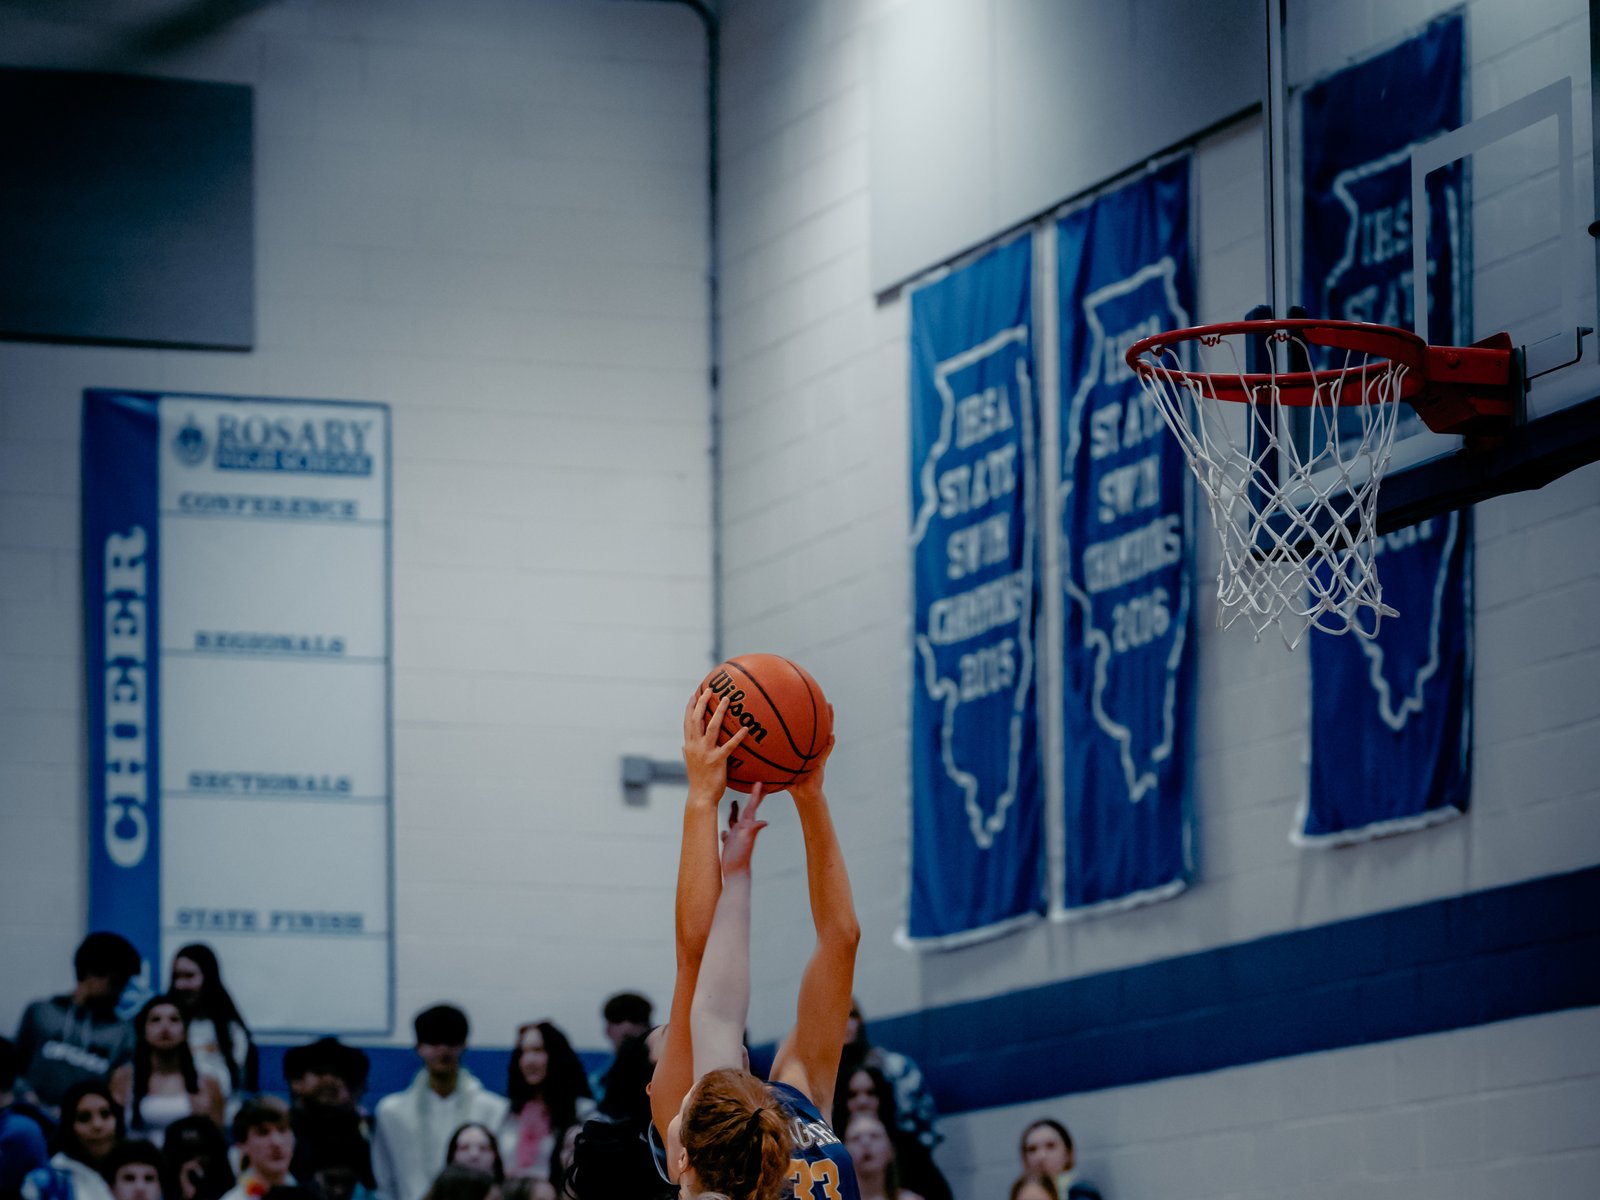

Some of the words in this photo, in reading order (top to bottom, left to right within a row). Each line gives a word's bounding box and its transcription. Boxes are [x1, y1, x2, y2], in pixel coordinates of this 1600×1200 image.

[217, 414, 373, 453] ROSARY
[179, 493, 357, 519] CONFERENCE
[939, 442, 1017, 519] STATE
[1098, 454, 1160, 524] SWIM
[946, 512, 1011, 580] SWIM
[195, 630, 346, 653] REGIONALS
[1112, 586, 1170, 653] 2016
[104, 524, 148, 868] CHEER
[959, 638, 1016, 702] 2015
[708, 669, 768, 745] Wilson
[188, 770, 352, 793] SECTIONALS
[176, 908, 257, 928] STATE
[269, 910, 364, 930] FINISH
